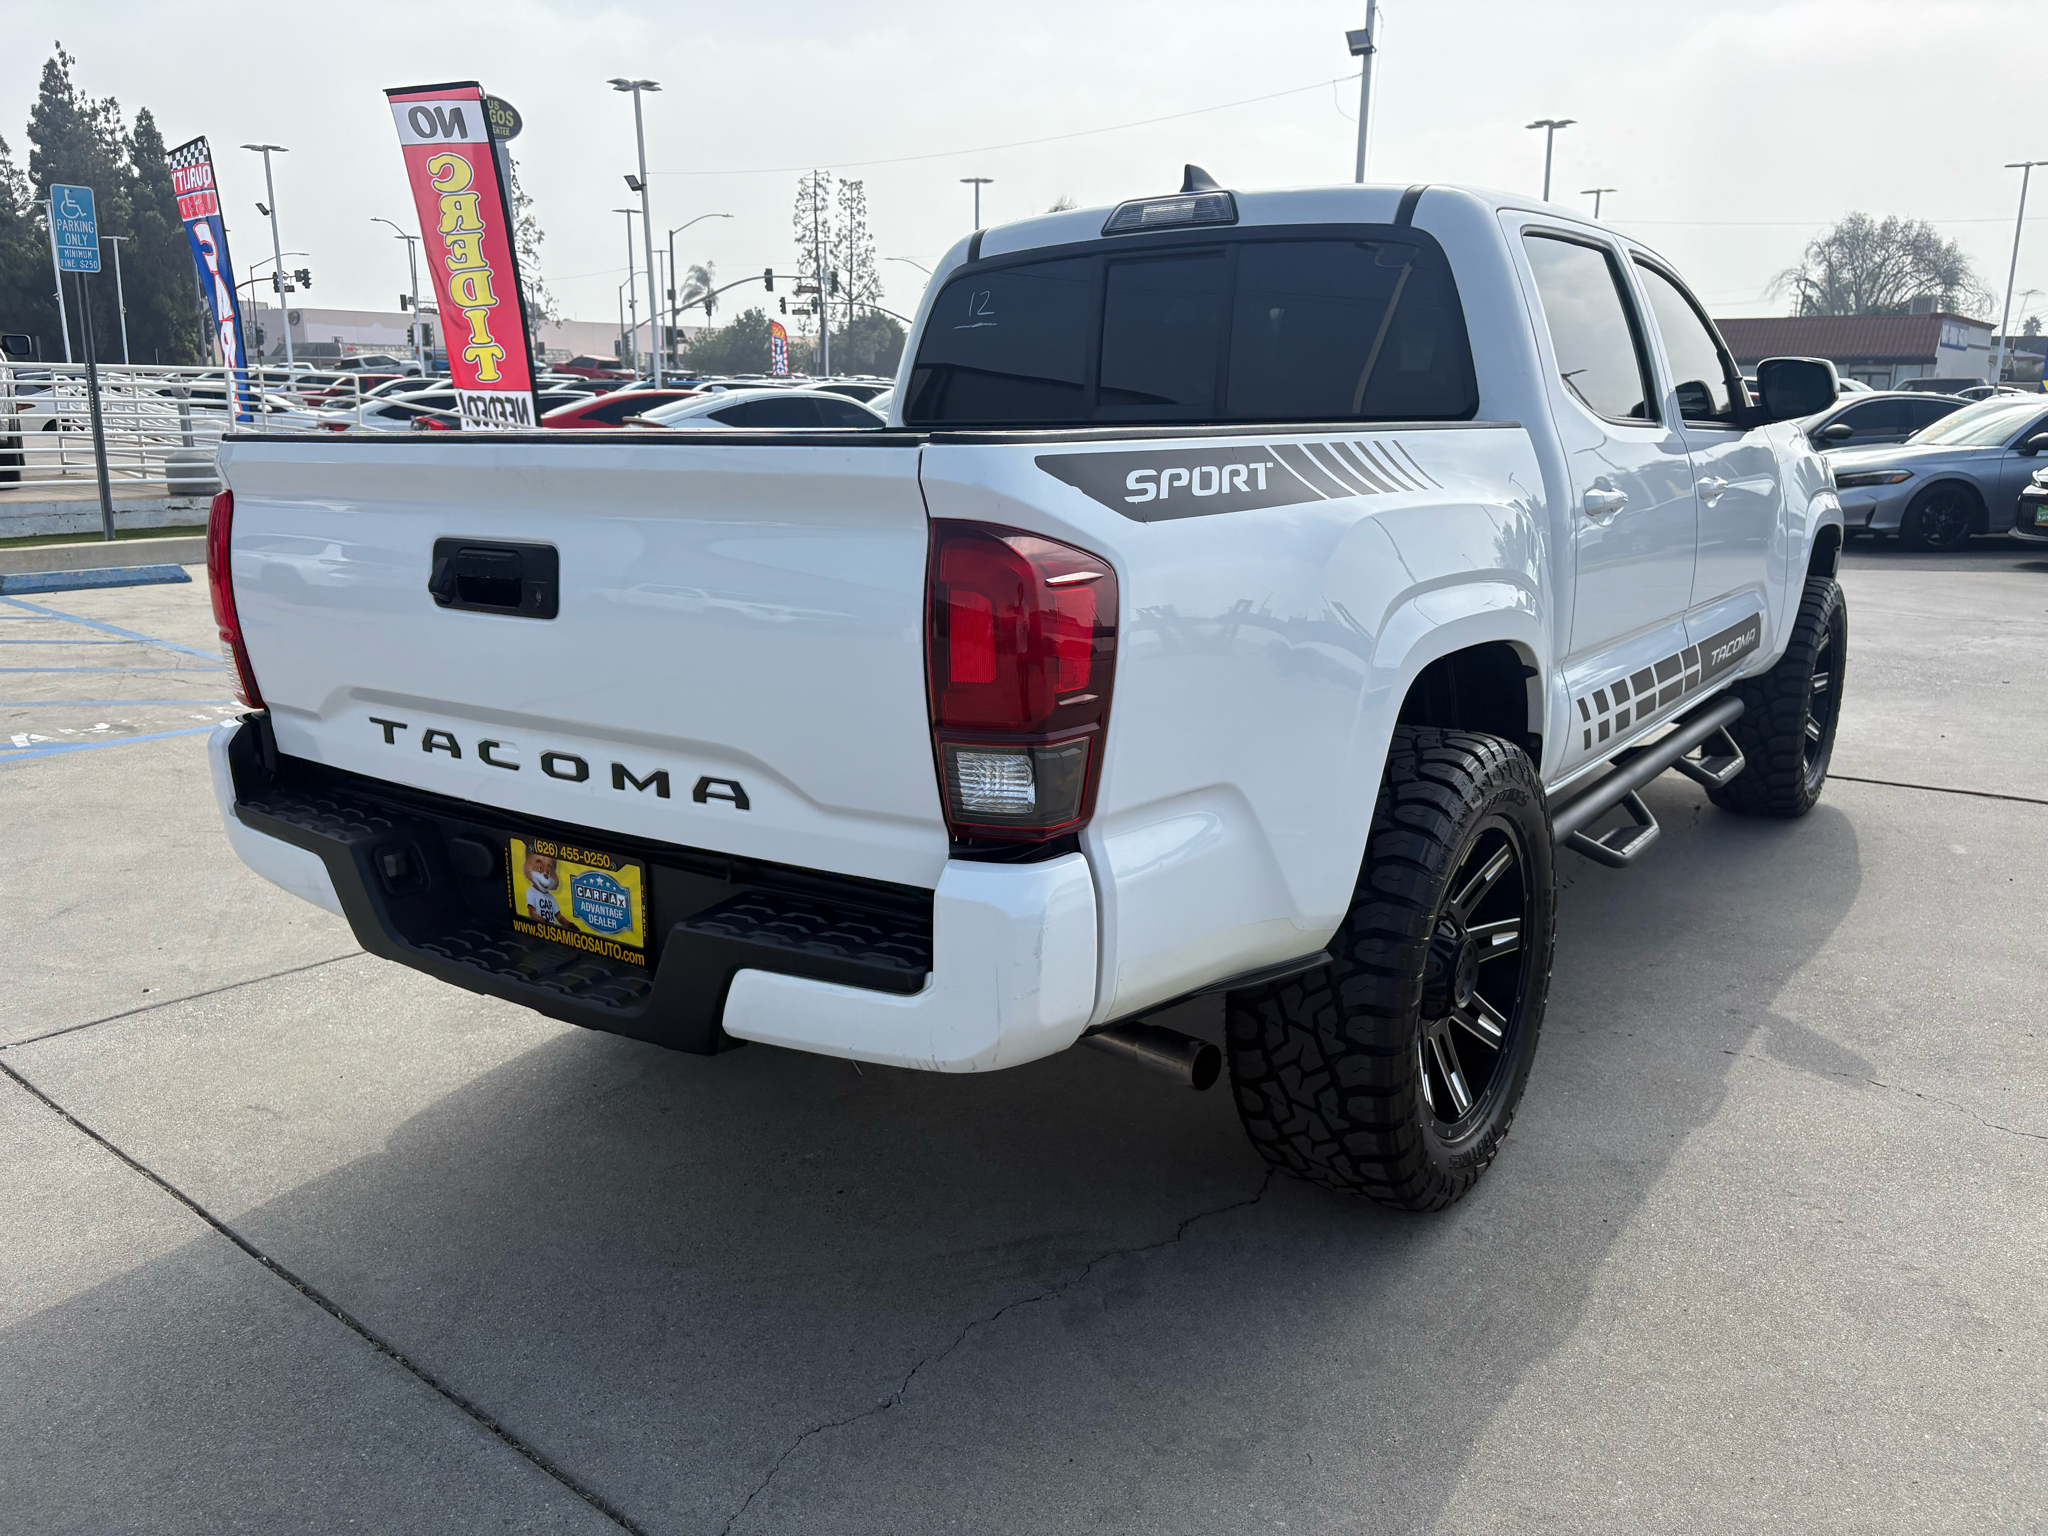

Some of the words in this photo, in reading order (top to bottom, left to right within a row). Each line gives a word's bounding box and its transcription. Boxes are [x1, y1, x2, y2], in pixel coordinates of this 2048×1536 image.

[489, 109, 514, 127] GOS
[492, 125, 510, 136] ENTER
[57, 219, 94, 234] PARKING
[65, 233, 88, 247] ONLY
[60, 258, 76, 268] FINE
[79, 259, 98, 269] $250
[64, 249, 93, 260] MINIMUM
[968, 290, 995, 317] 12
[1124, 462, 1274, 504] SPORT
[1711, 627, 1756, 667] TACOMA
[369, 716, 751, 811] TACOMA
[534, 838, 558, 858] (626)
[560, 846, 610, 868] 455-0250
[539, 898, 553, 911] CAR
[576, 885, 627, 909] CARFAX
[580, 901, 624, 920] ADVANTAGE
[588, 913, 618, 930] DEALER
